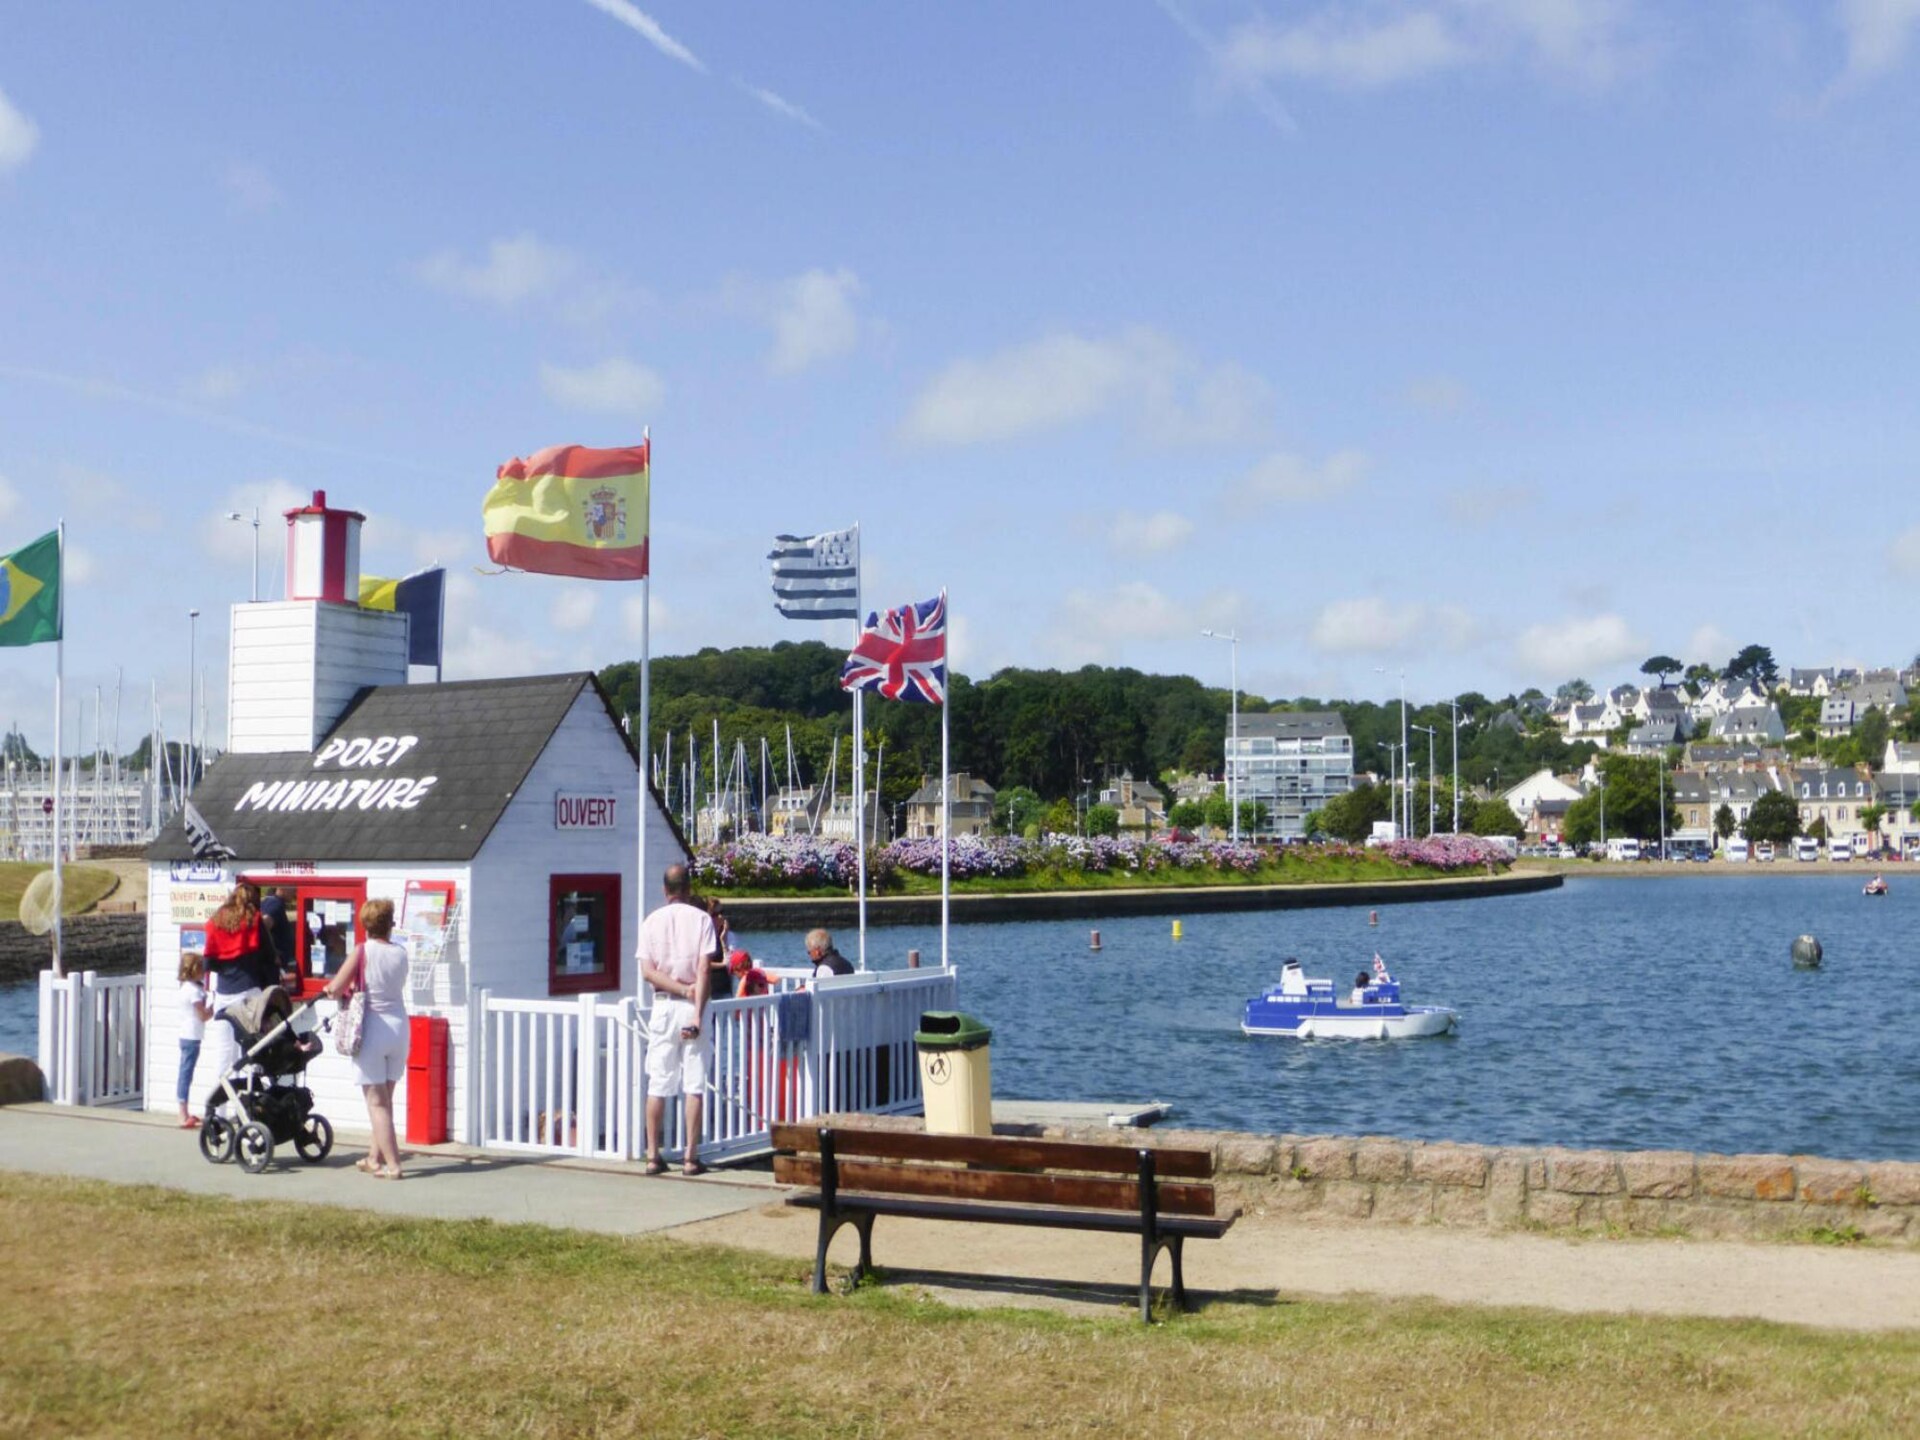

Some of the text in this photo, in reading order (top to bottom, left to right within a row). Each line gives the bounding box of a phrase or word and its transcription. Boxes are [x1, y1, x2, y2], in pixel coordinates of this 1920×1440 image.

[313, 735, 419, 767] PORT
[234, 775, 438, 811] MINIATURE
[558, 798, 616, 826] OUVERT
[169, 891, 198, 902] OUVERT
[198, 891, 206, 901] A
